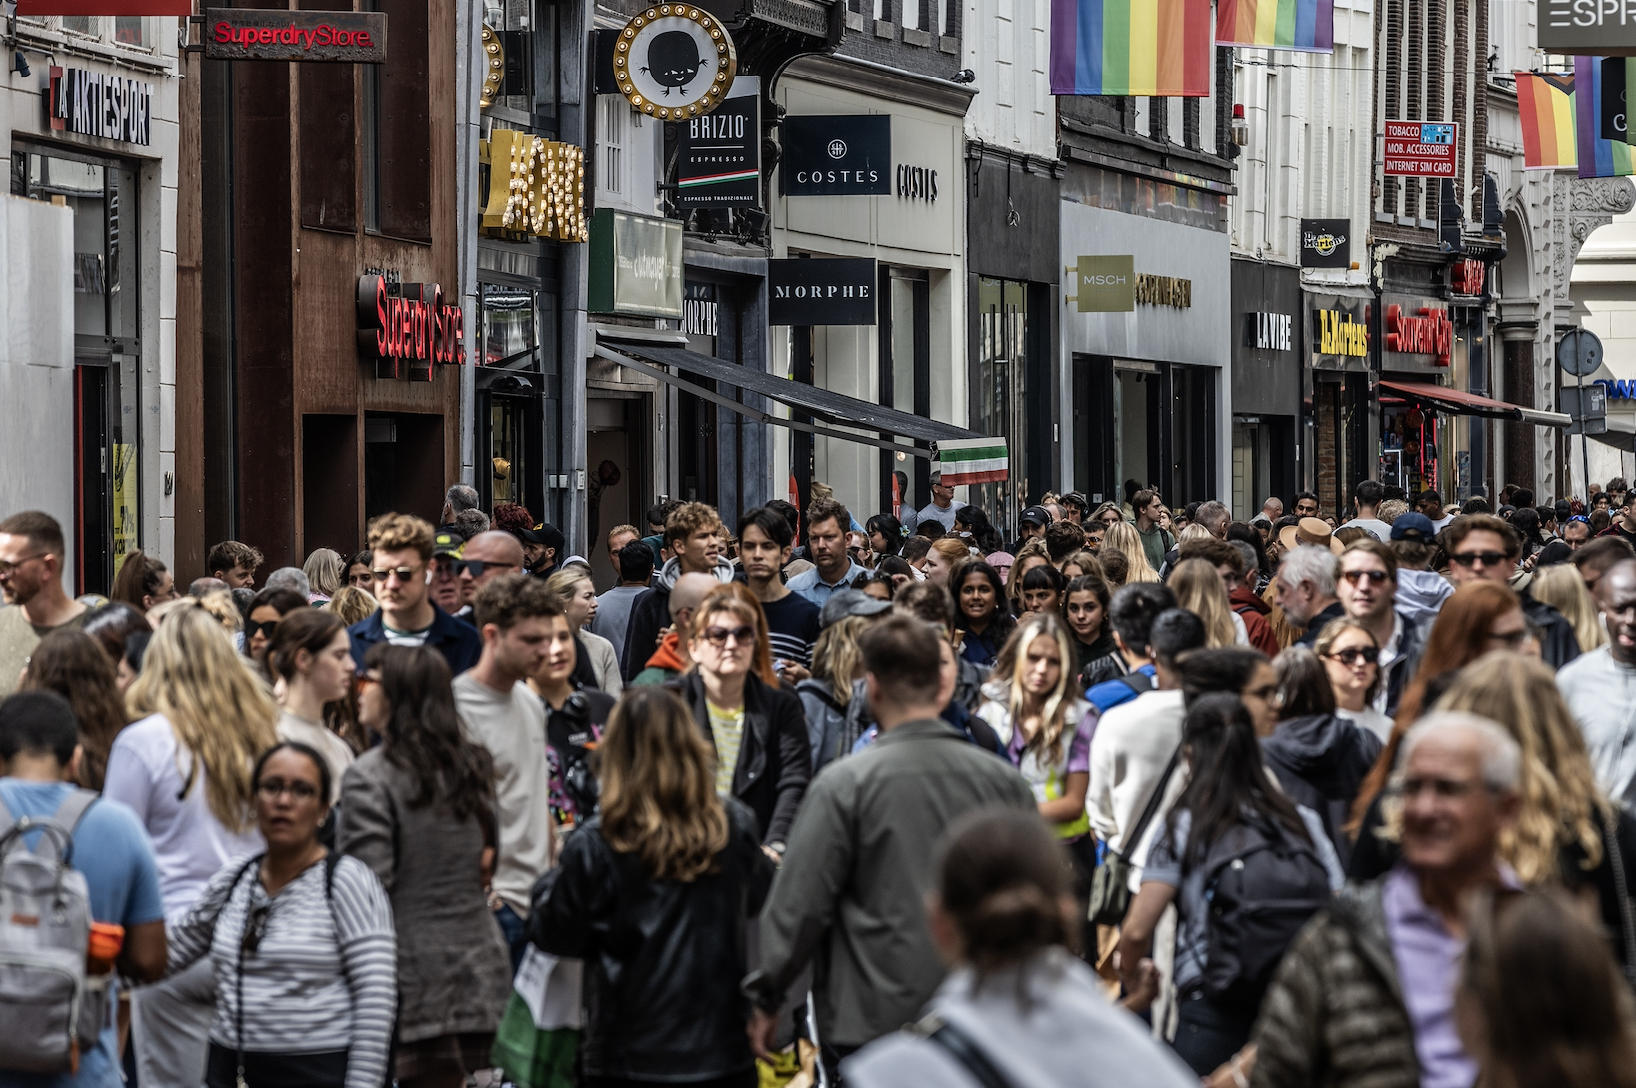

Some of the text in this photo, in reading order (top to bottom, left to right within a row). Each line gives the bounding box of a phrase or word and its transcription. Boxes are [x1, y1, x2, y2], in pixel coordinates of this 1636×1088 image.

[73, 68, 154, 146] AKTIESPORT
[690, 115, 744, 138] BRIZIO
[1388, 125, 1420, 137] TOBACCO
[1387, 143, 1449, 155] MOB. ACCESSORIES
[1386, 160, 1452, 173] INTERNET SIM CARD
[797, 170, 879, 184] COSTES
[1083, 275, 1126, 285] MSCH
[775, 285, 869, 298] MORPHE
